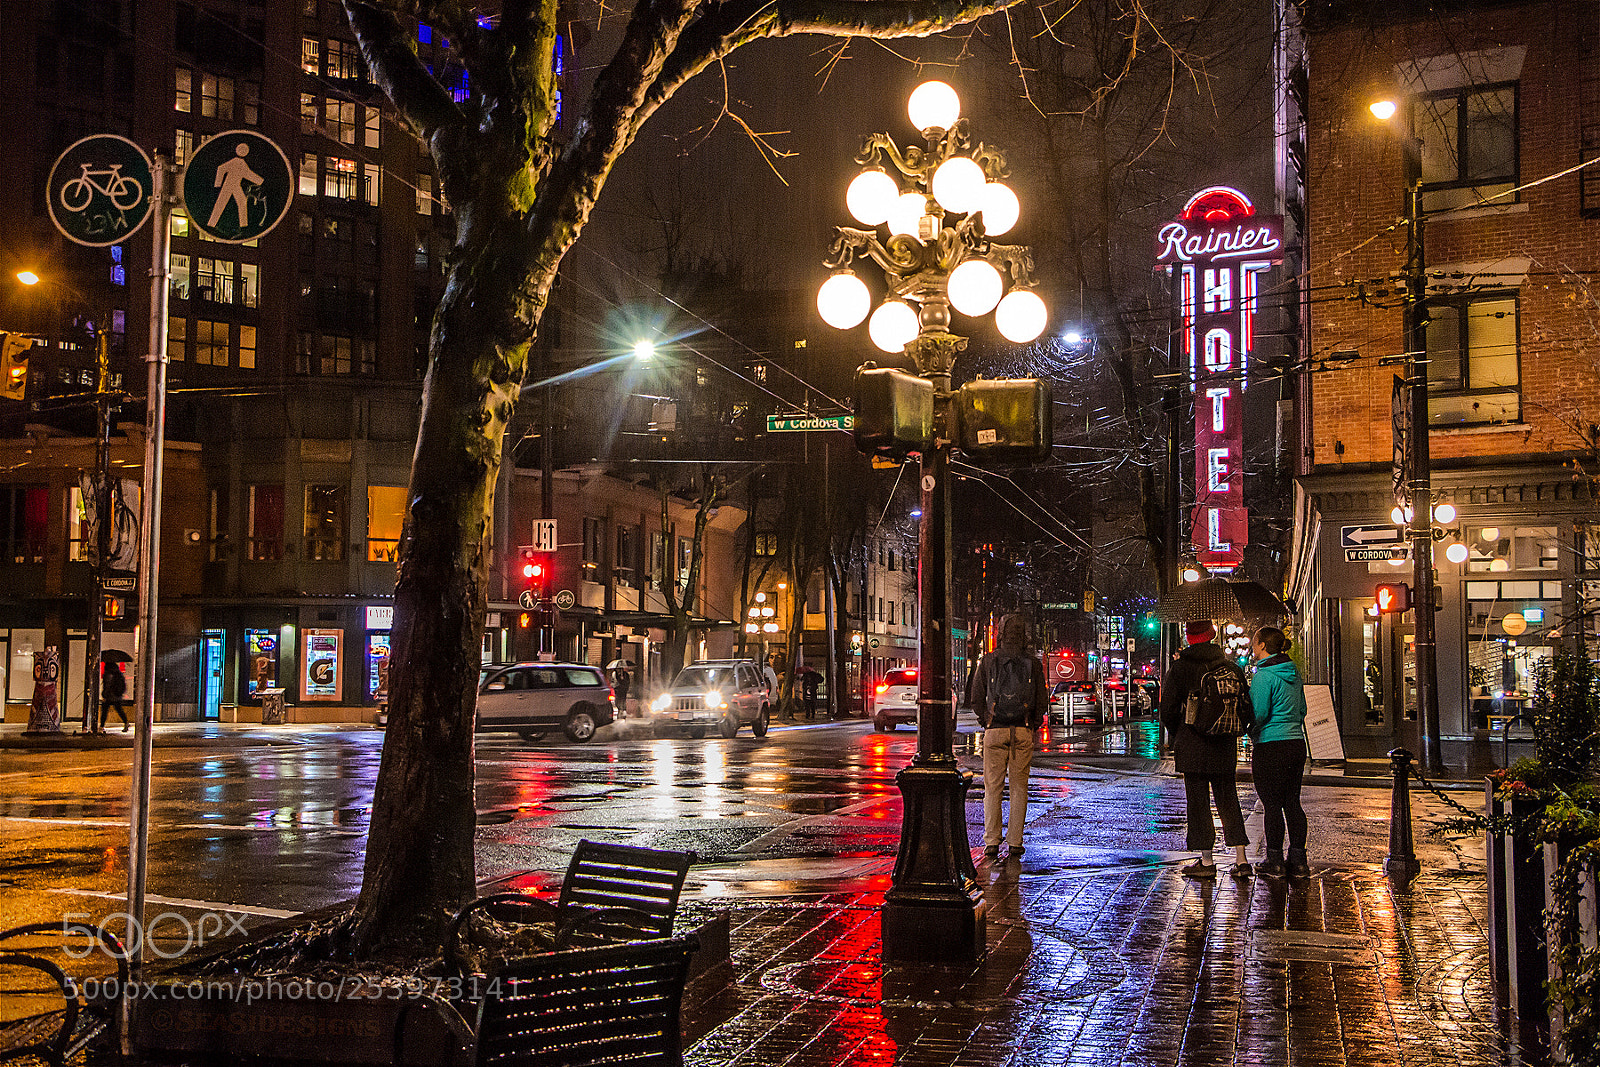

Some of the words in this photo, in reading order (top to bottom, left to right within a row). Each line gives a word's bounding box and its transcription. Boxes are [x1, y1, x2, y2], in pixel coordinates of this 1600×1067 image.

[1156, 223, 1280, 262] Rainier
[774, 420, 786, 429] W
[790, 417, 839, 429] Cordova
[843, 416, 855, 428] S
[1203, 267, 1232, 553] HOTEL
[1349, 551, 1357, 560] W
[1357, 550, 1393, 560] CORDOVA
